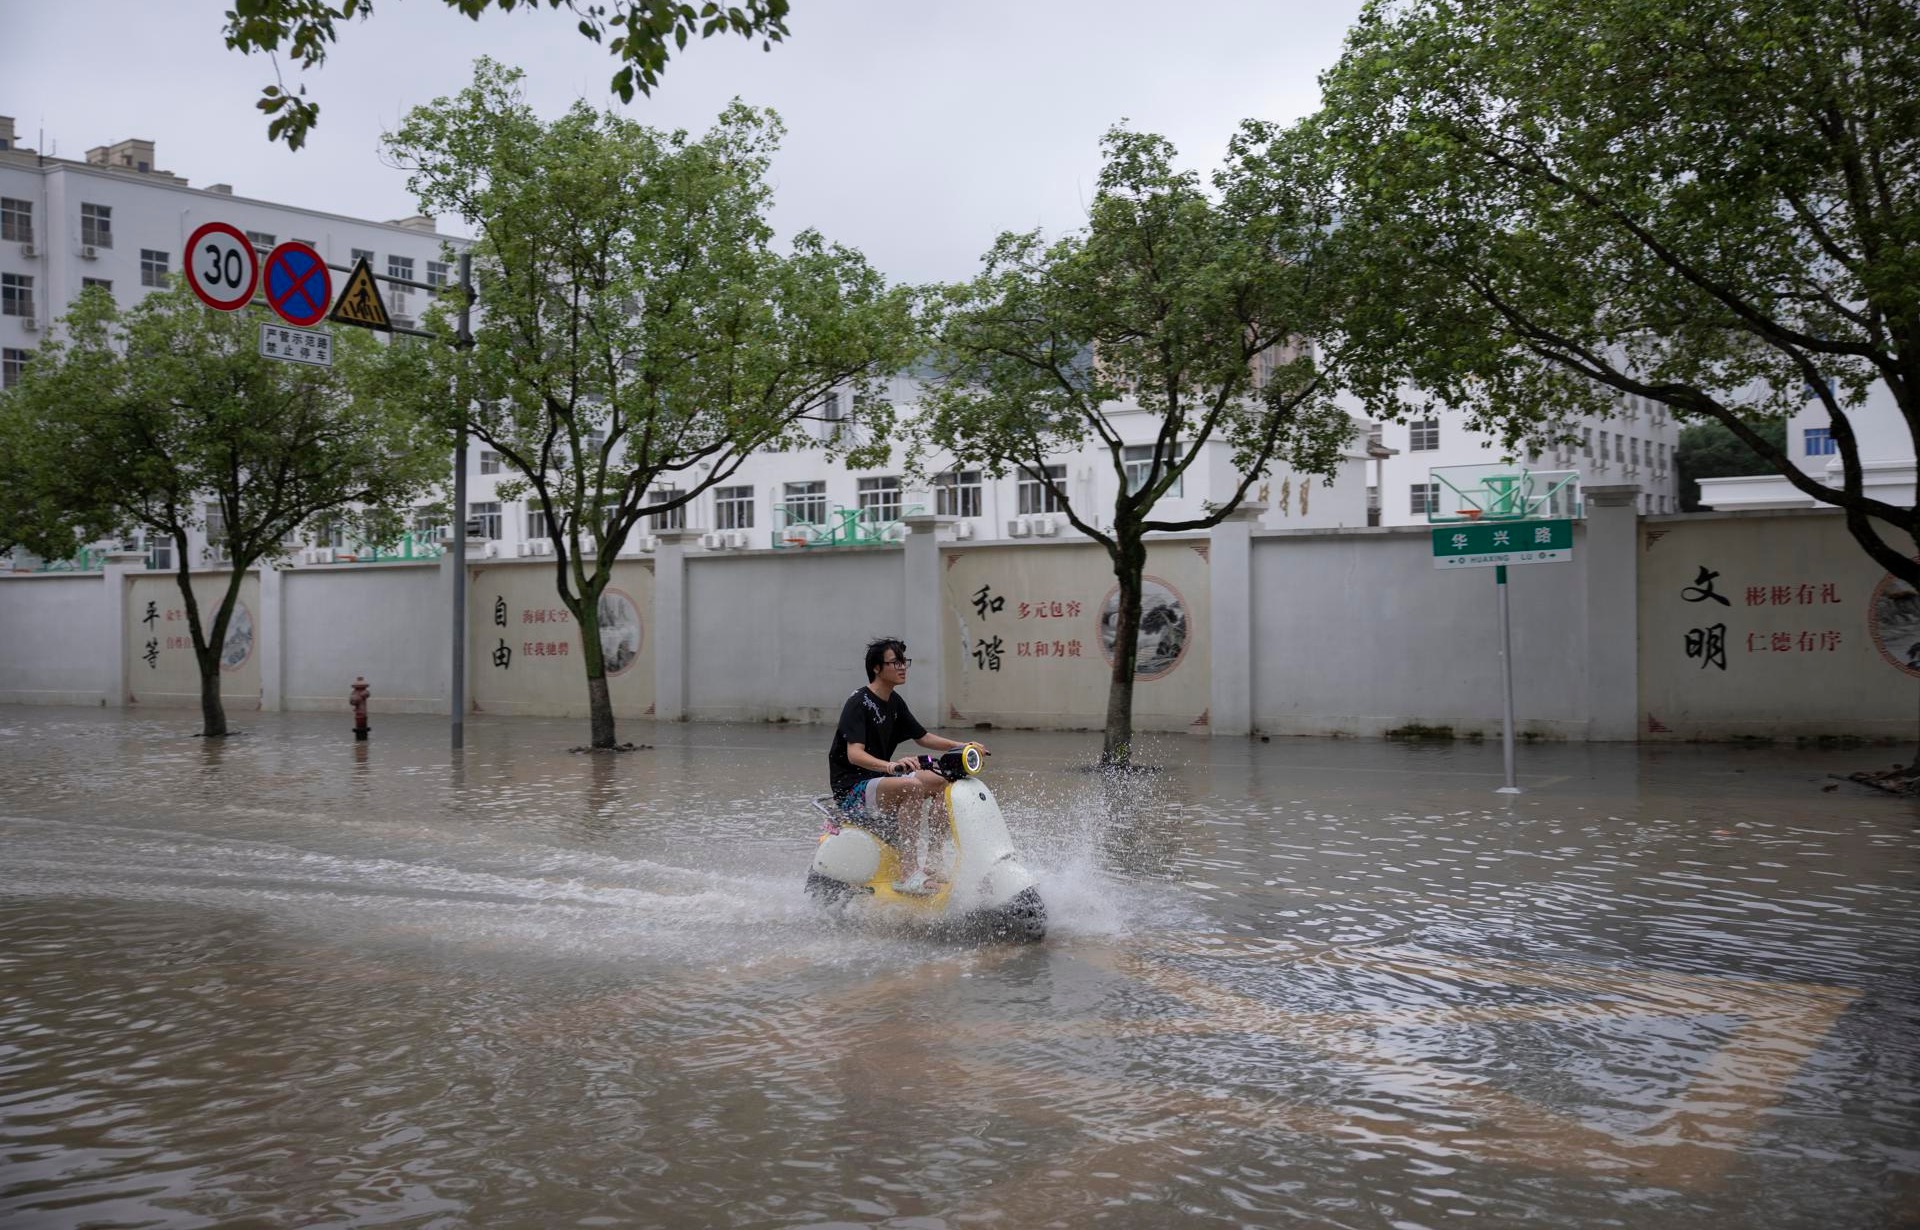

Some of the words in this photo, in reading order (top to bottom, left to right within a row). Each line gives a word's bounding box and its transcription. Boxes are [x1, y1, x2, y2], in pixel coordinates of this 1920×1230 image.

[203, 244, 243, 289] 30
[266, 342, 326, 361] 禁止停车
[1451, 526, 1553, 550] 华兴路
[1470, 555, 1510, 563] HUAXING
[1745, 583, 1842, 607] 彬彬有礼
[1018, 601, 1081, 619] 多元包容
[1680, 565, 1732, 671] 文明
[142, 601, 160, 669] 平等
[492, 595, 513, 670] 自由
[971, 584, 1006, 673] 和谐
[1017, 638, 1083, 657] 以和为贵
[1746, 630, 1842, 653] 仁德有序
